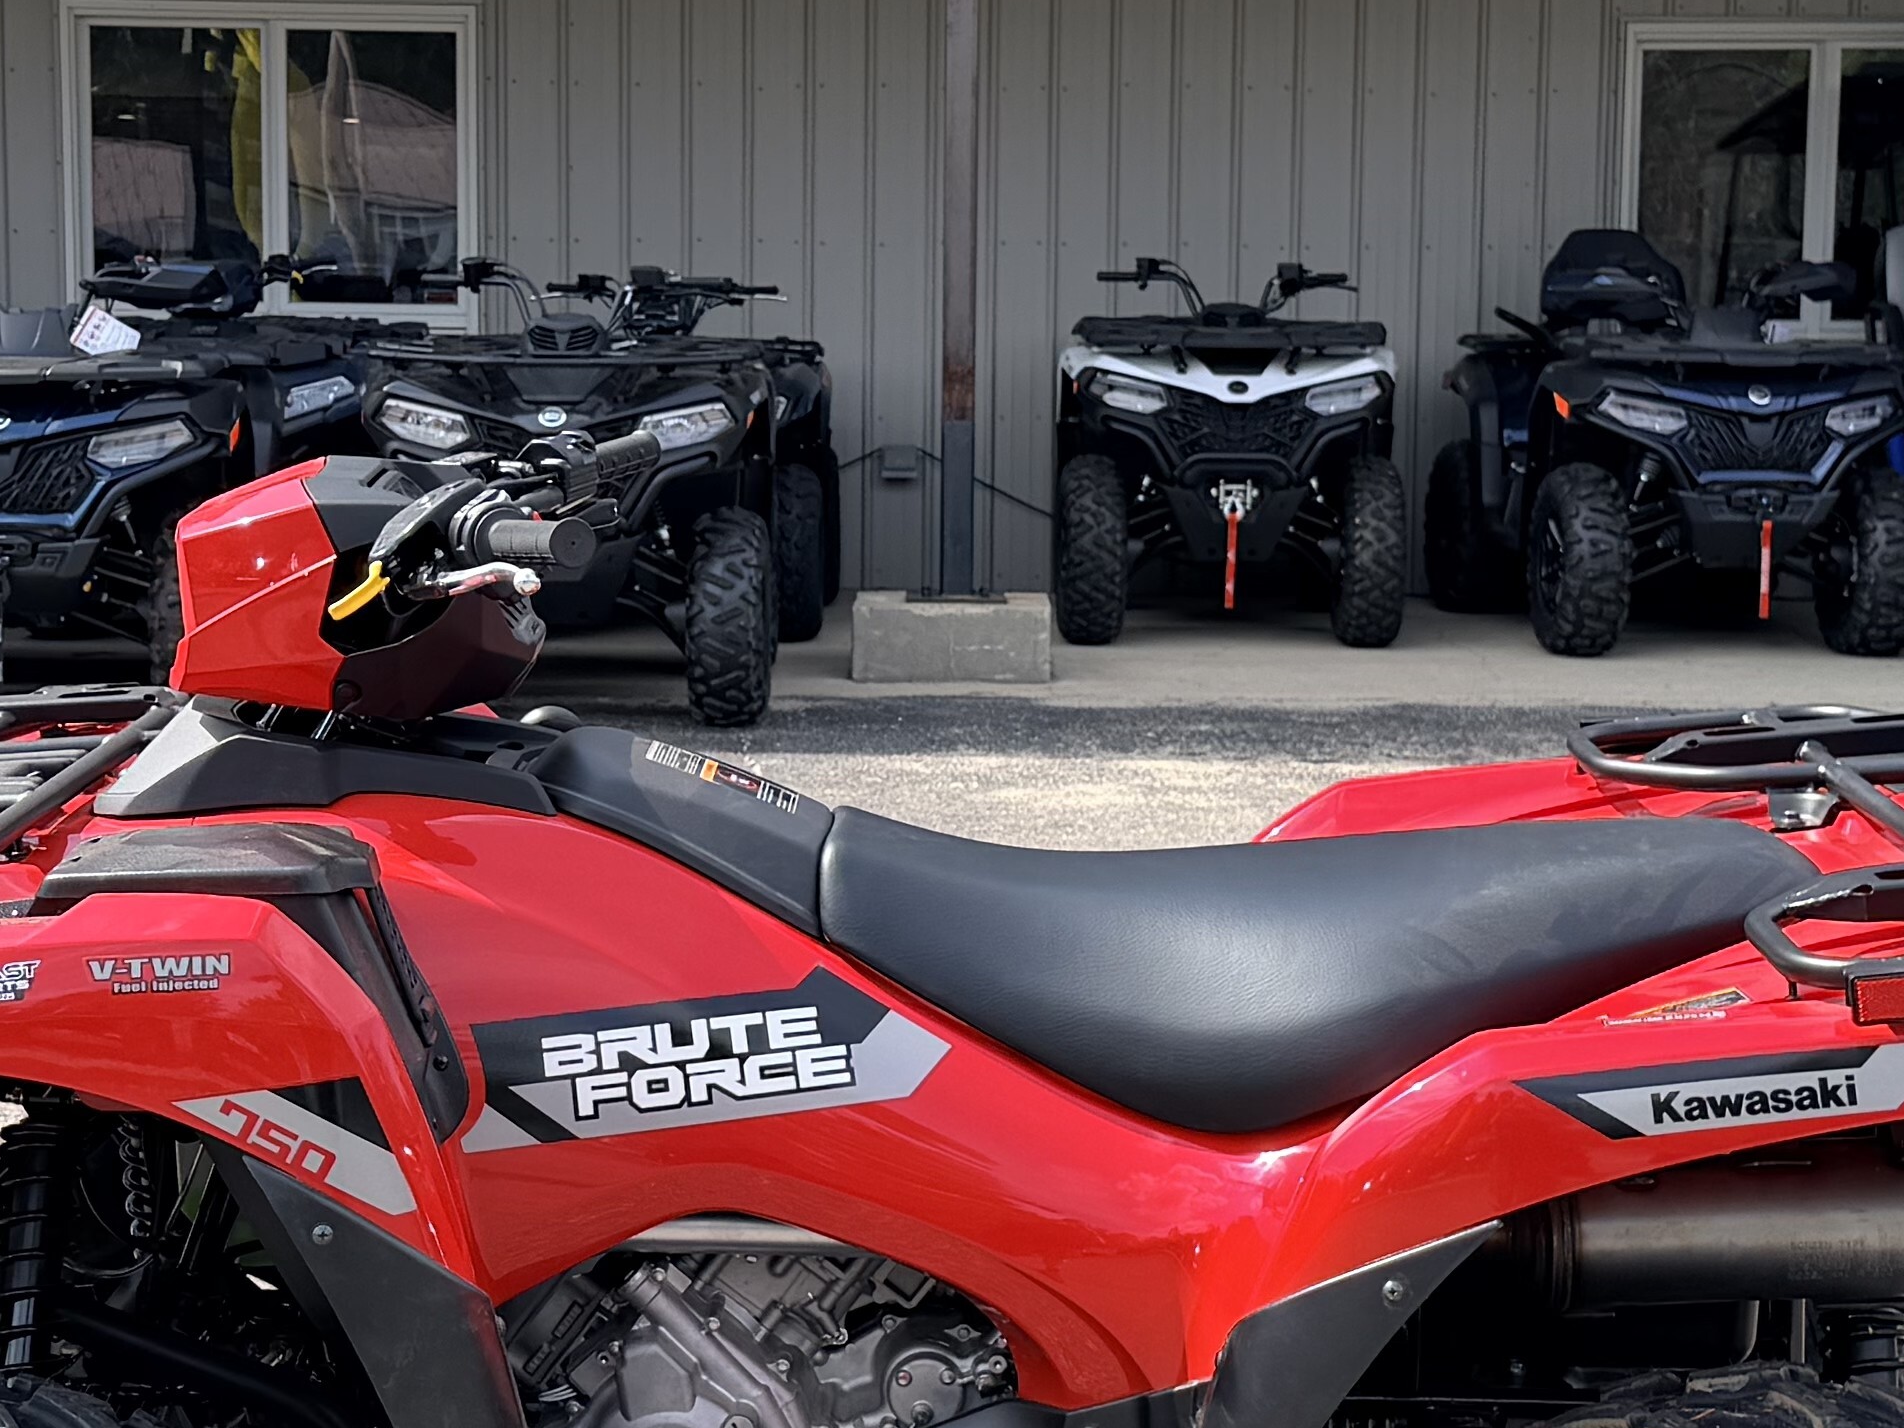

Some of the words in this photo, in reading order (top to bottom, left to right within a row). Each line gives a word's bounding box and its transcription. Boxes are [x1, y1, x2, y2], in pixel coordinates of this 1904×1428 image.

[88, 954, 231, 980] V-TWIN
[113, 981, 147, 994] Fuel
[151, 978, 219, 992] Injected
[541, 1006, 822, 1078] BRUTE
[575, 1044, 852, 1118] FORCE
[1650, 1074, 1858, 1124] Kawasaki
[219, 1098, 337, 1183] 750
